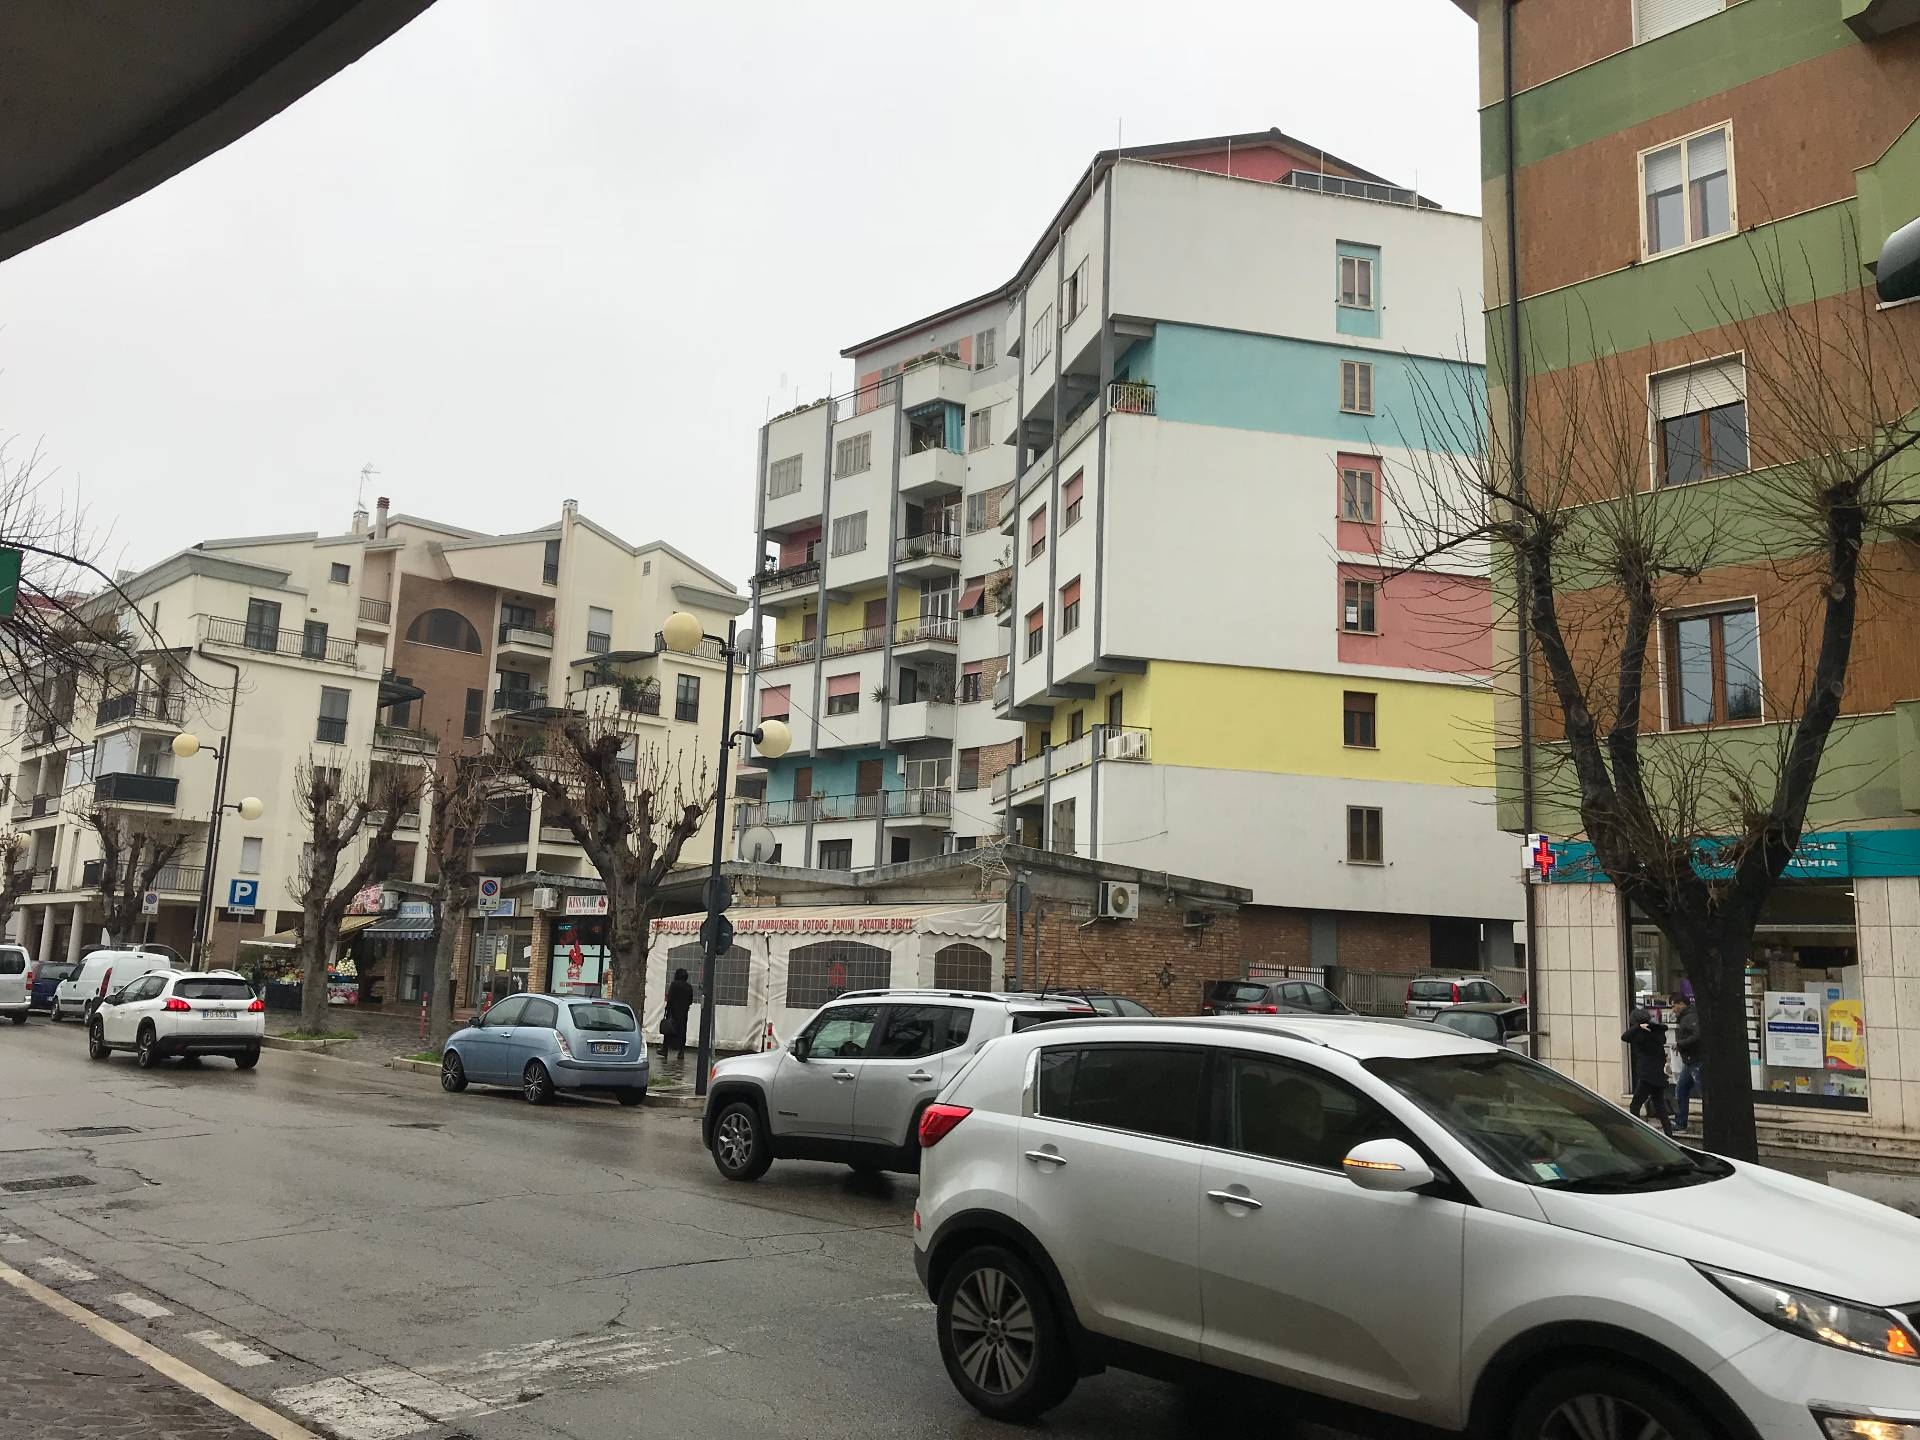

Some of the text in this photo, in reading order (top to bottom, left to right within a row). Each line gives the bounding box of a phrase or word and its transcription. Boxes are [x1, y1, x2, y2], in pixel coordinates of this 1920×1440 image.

[234, 882, 252, 903] P
[670, 920, 685, 930] DOLCI
[737, 920, 755, 931] TOAST
[757, 919, 799, 931] HAMBURGHER
[802, 919, 829, 930] HOTDOG
[832, 918, 855, 930] PANINI
[858, 918, 889, 930] PATATINE
[890, 918, 913, 930] BIBITE
